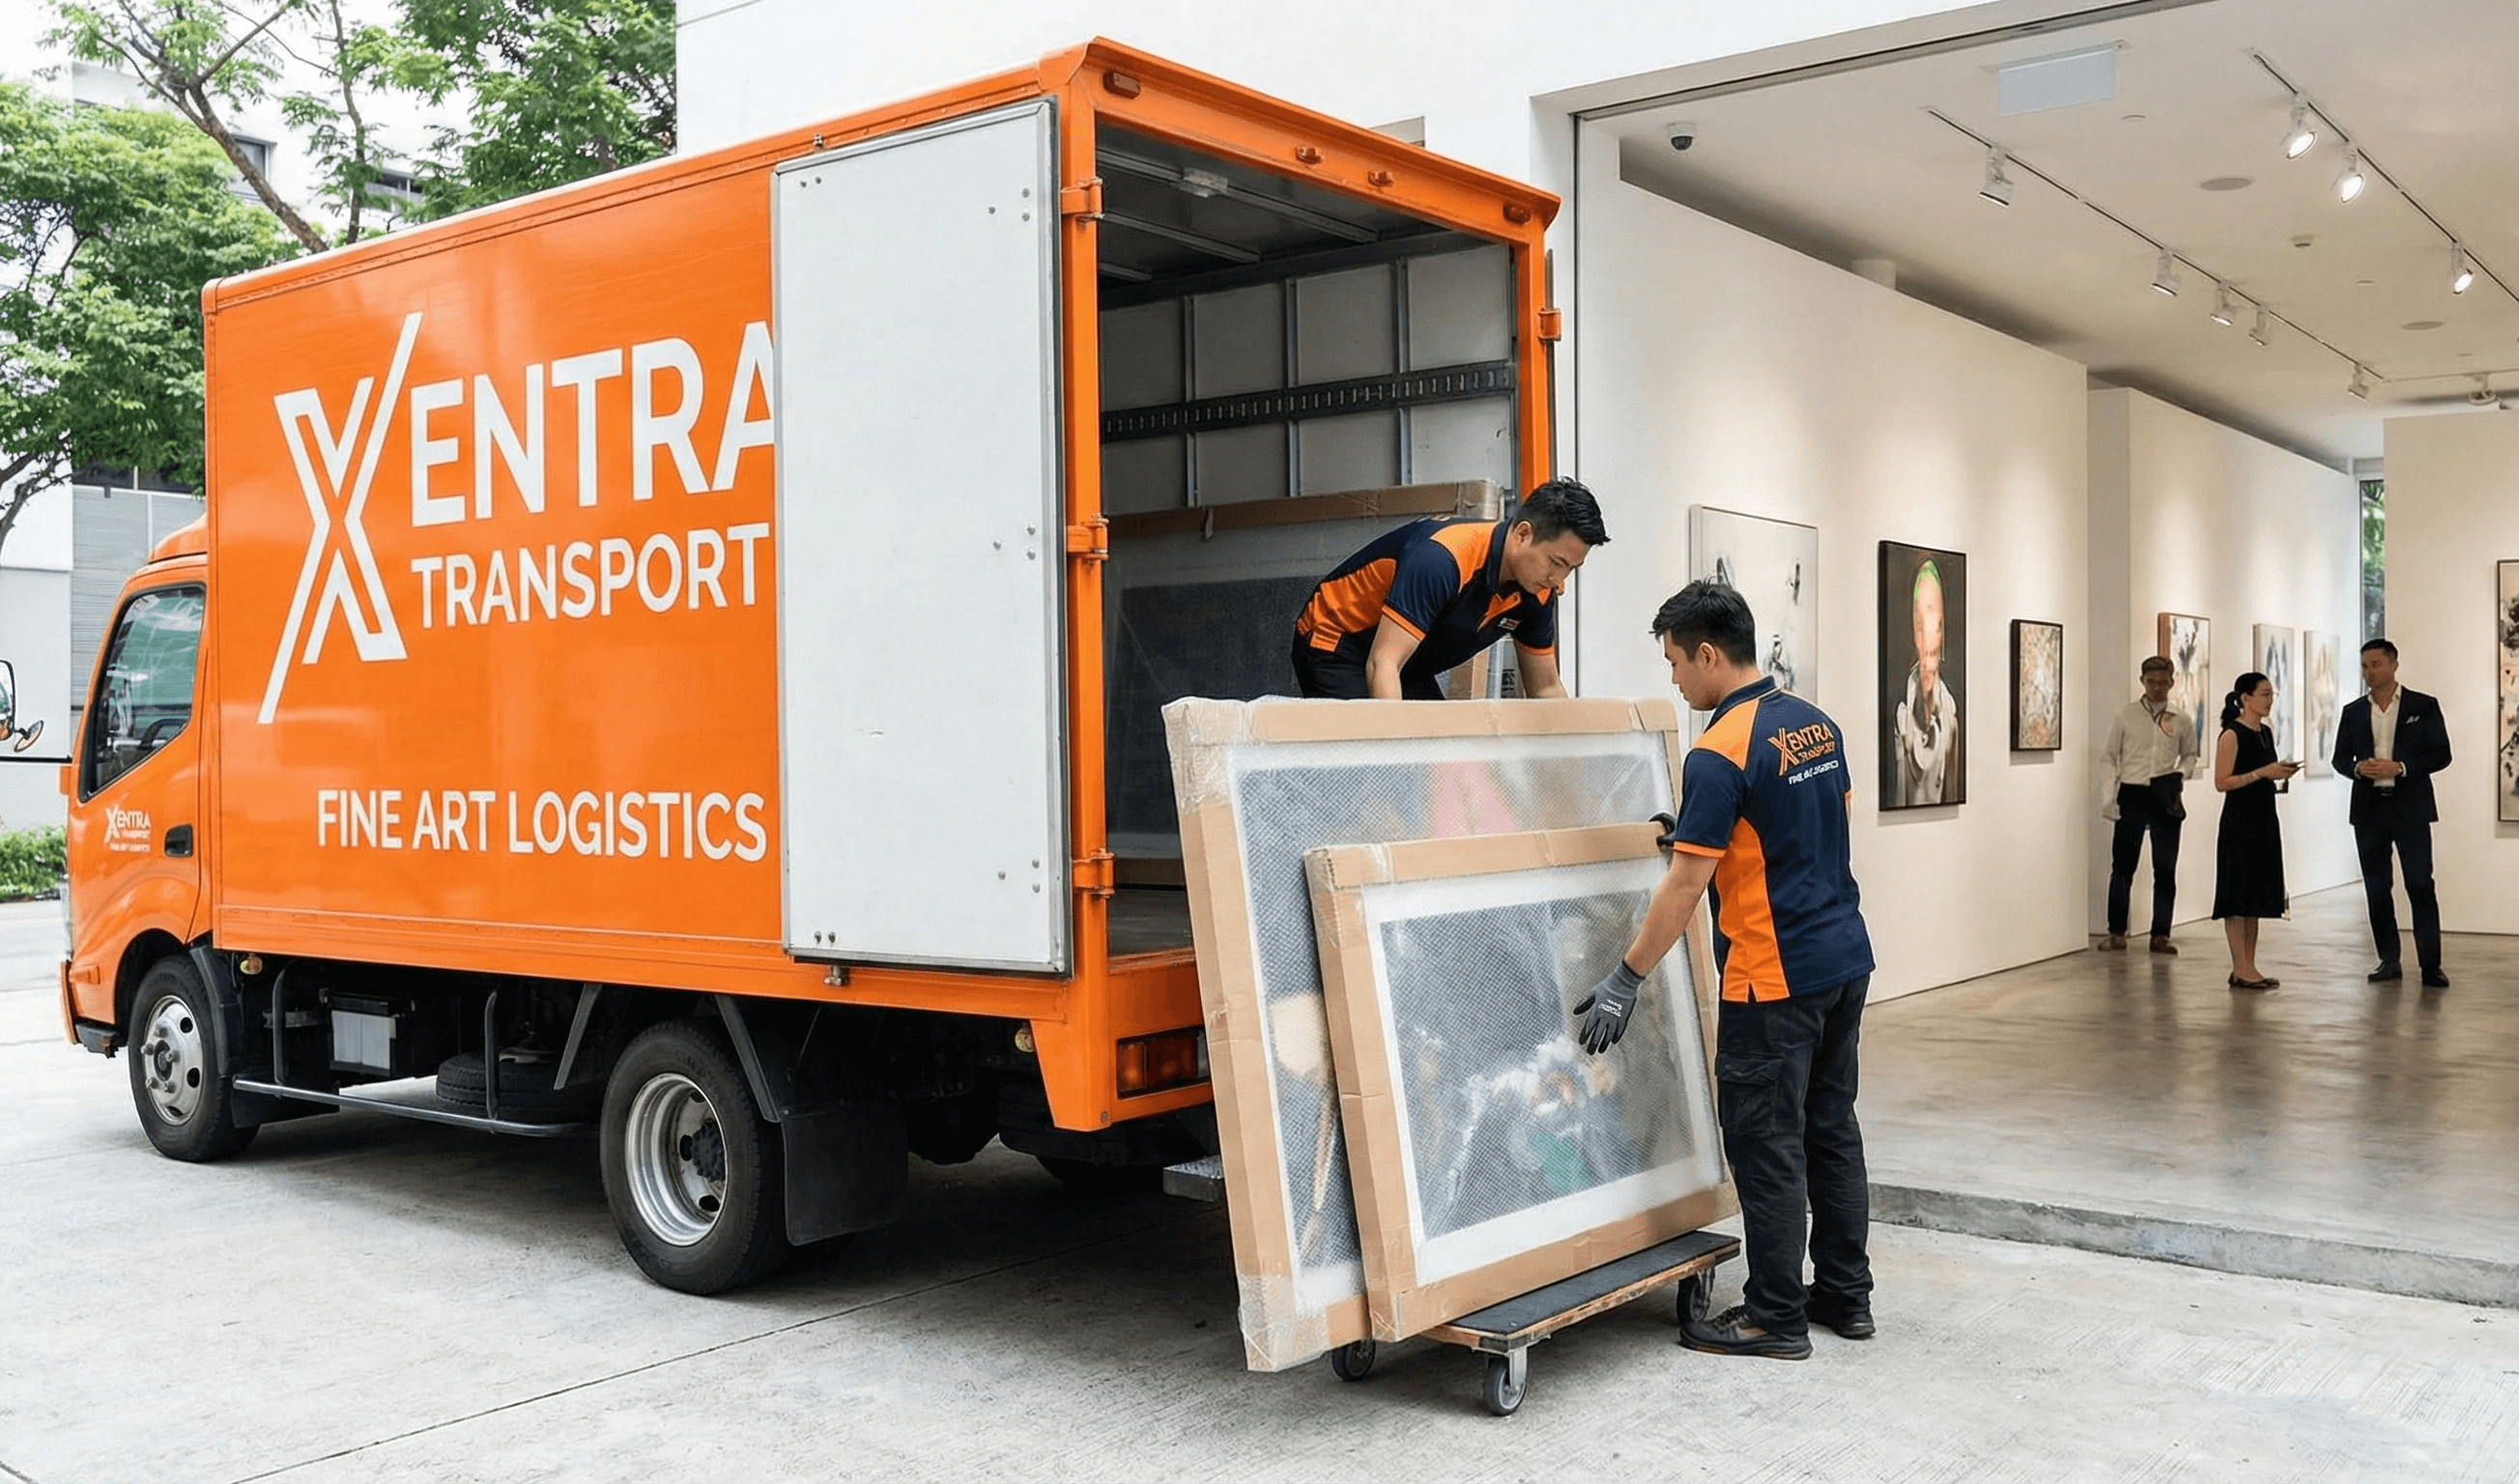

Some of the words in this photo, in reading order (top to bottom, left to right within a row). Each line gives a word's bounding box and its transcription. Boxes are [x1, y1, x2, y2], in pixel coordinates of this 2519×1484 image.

[257, 311, 774, 725] XENTRA
[411, 523, 769, 629] TRANSPORT
[1767, 723, 1835, 777] XENTRA
[103, 804, 152, 843] XENTRA
[318, 789, 403, 847] FINE
[412, 790, 497, 851] ART
[508, 790, 766, 862] LOGISTICS
